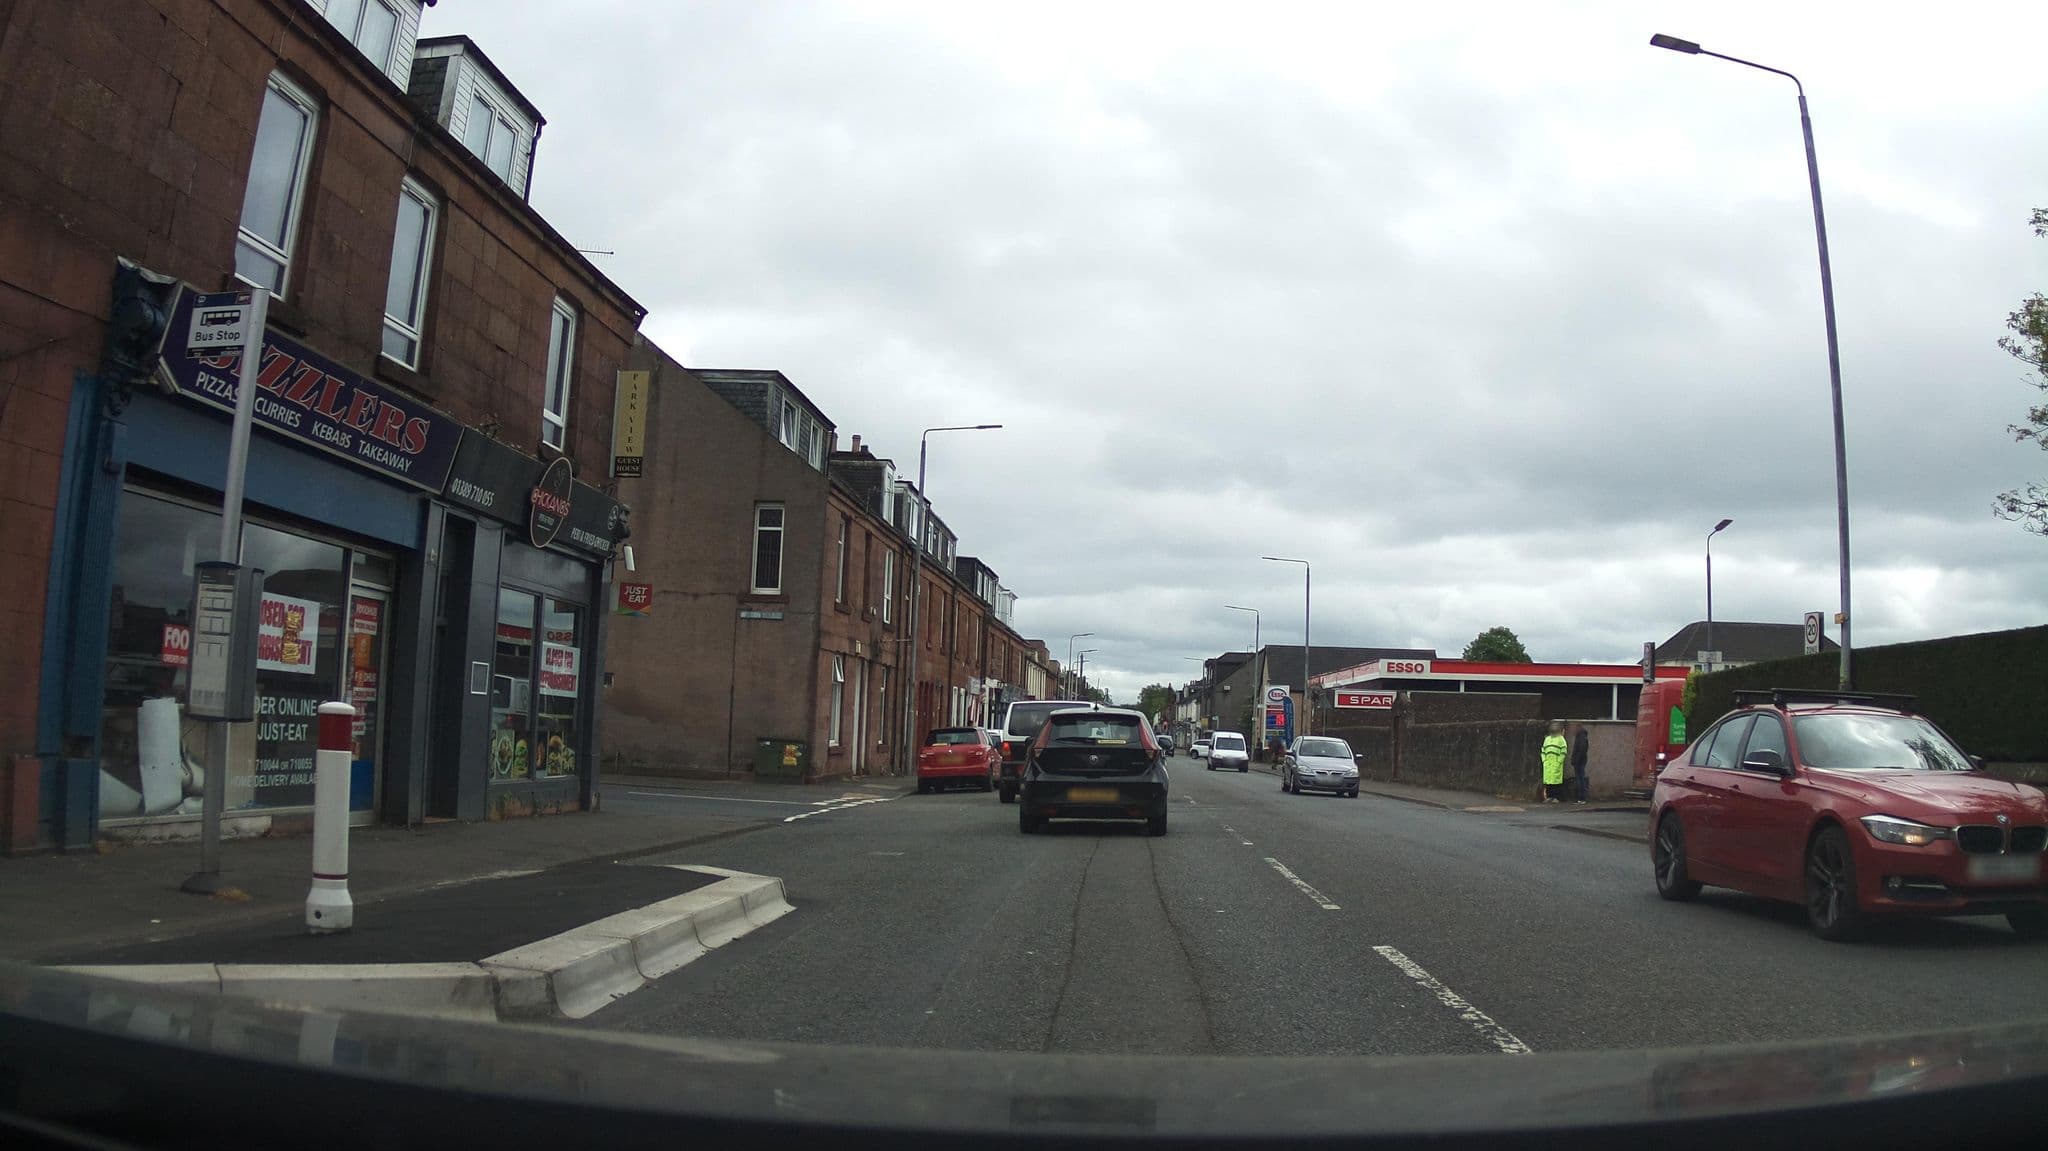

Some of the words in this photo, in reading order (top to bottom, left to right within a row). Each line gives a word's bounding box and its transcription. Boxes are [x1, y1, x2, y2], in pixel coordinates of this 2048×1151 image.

[195, 331, 214, 342] Bus
[216, 330, 241, 342] Stop
[630, 373, 639, 410] PARK
[254, 397, 302, 428] CURRIES
[311, 420, 351, 449] KEBABS
[358, 439, 412, 473] TAKEAWAY
[625, 416, 633, 453] VIEW
[617, 457, 642, 465] GUEST
[616, 464, 641, 473] HOUSE
[624, 586, 649, 595] JUST
[628, 594, 647, 603] EAT
[1807, 623, 1817, 636] 20
[1386, 661, 1425, 674] ESSO
[254, 695, 276, 715] DER
[278, 697, 317, 716] ONLINE
[1349, 695, 1393, 705] SPAR
[257, 722, 308, 741] JUST-EAT
[254, 774, 289, 788] DELIVERY
